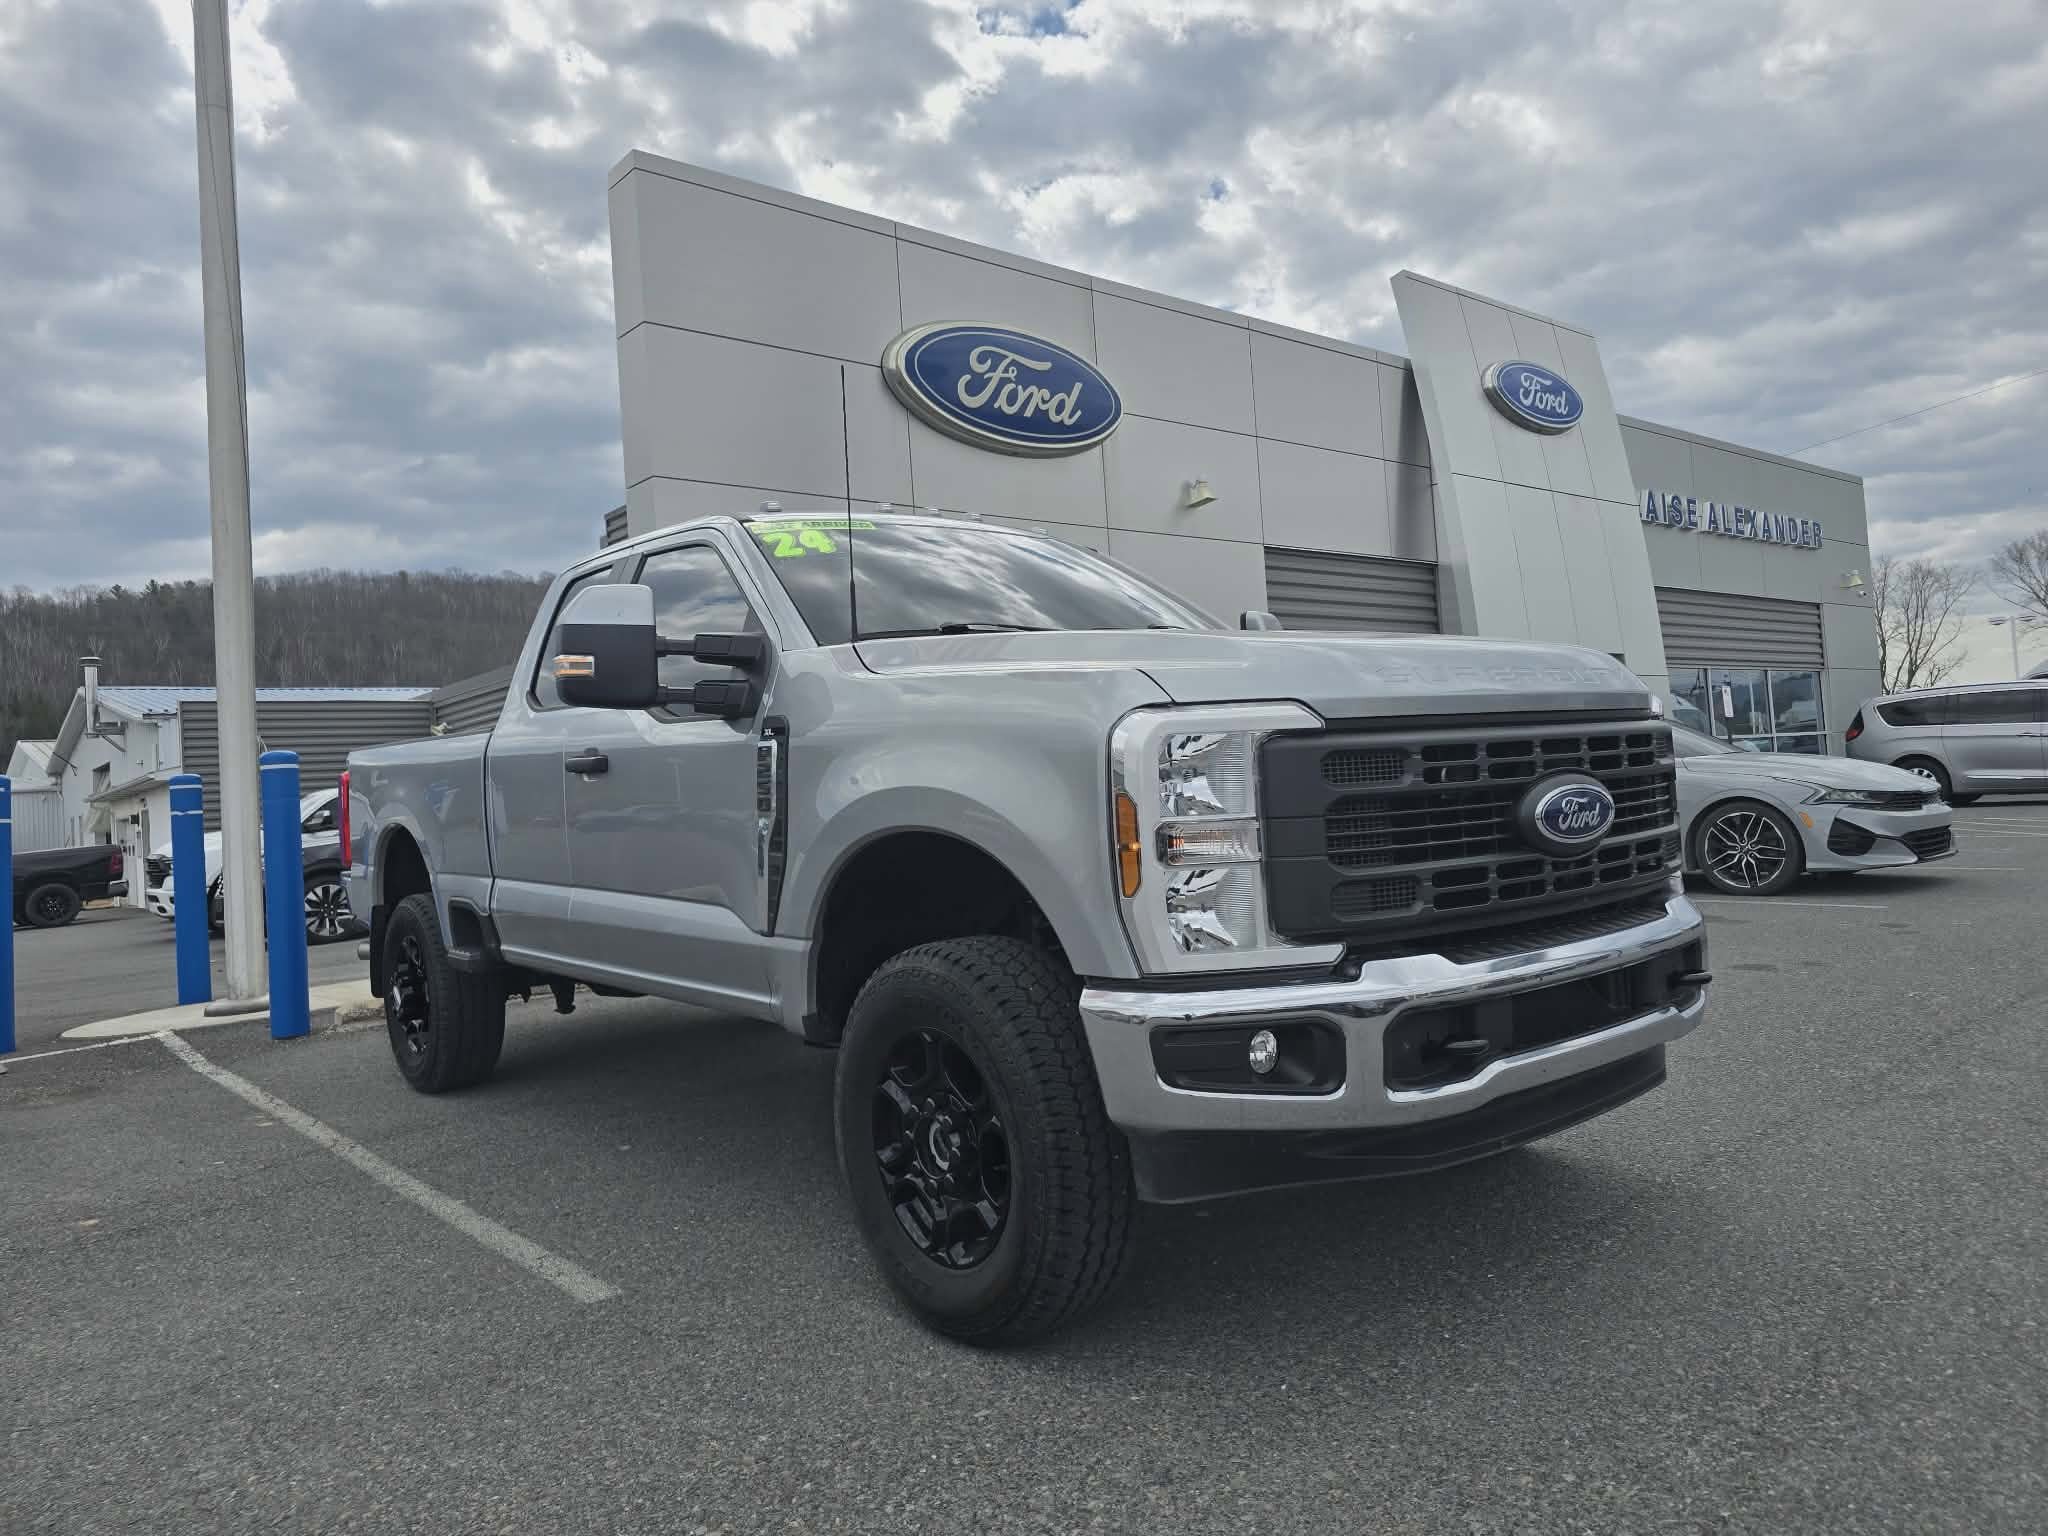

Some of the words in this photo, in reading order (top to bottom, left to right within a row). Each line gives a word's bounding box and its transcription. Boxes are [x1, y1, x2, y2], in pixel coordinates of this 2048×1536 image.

[957, 345, 1083, 426] Ford
[1519, 372, 1569, 416] Ford
[1640, 489, 1698, 529] AISE
[1701, 501, 1824, 548] ALEXANDER
[1558, 796, 1601, 831] Ford
